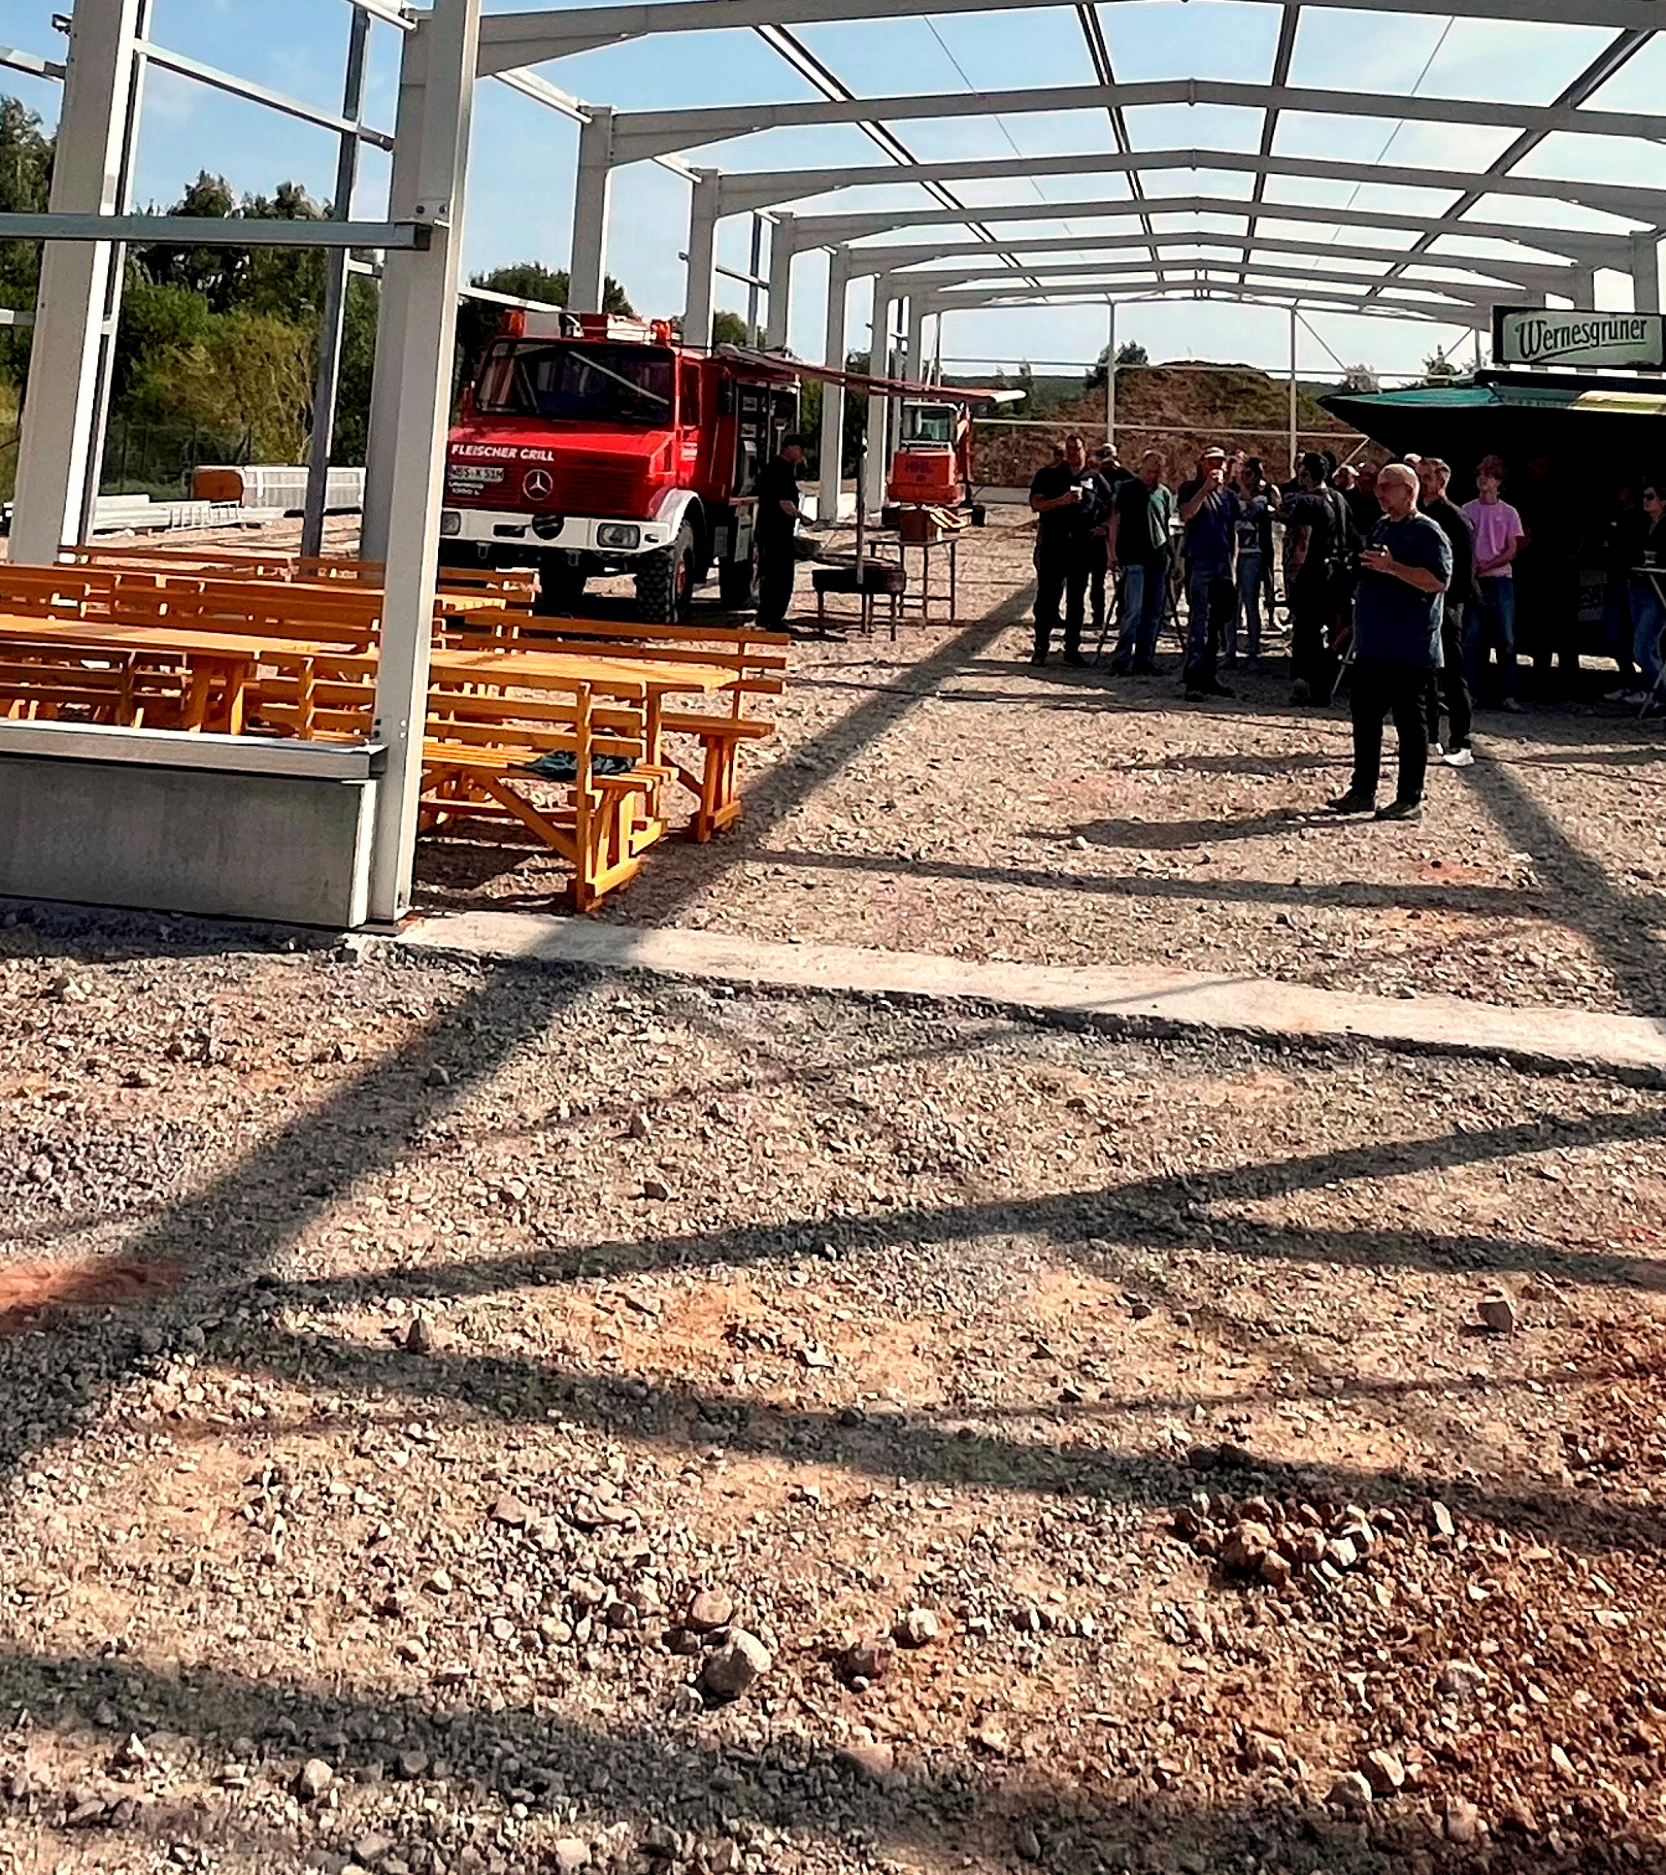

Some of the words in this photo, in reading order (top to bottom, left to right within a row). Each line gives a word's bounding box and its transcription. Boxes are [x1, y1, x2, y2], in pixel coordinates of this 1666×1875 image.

[1515, 314, 1647, 359] Wernesgrüner
[451, 444, 517, 458] FLEISCHER
[520, 448, 554, 461] GRILL
